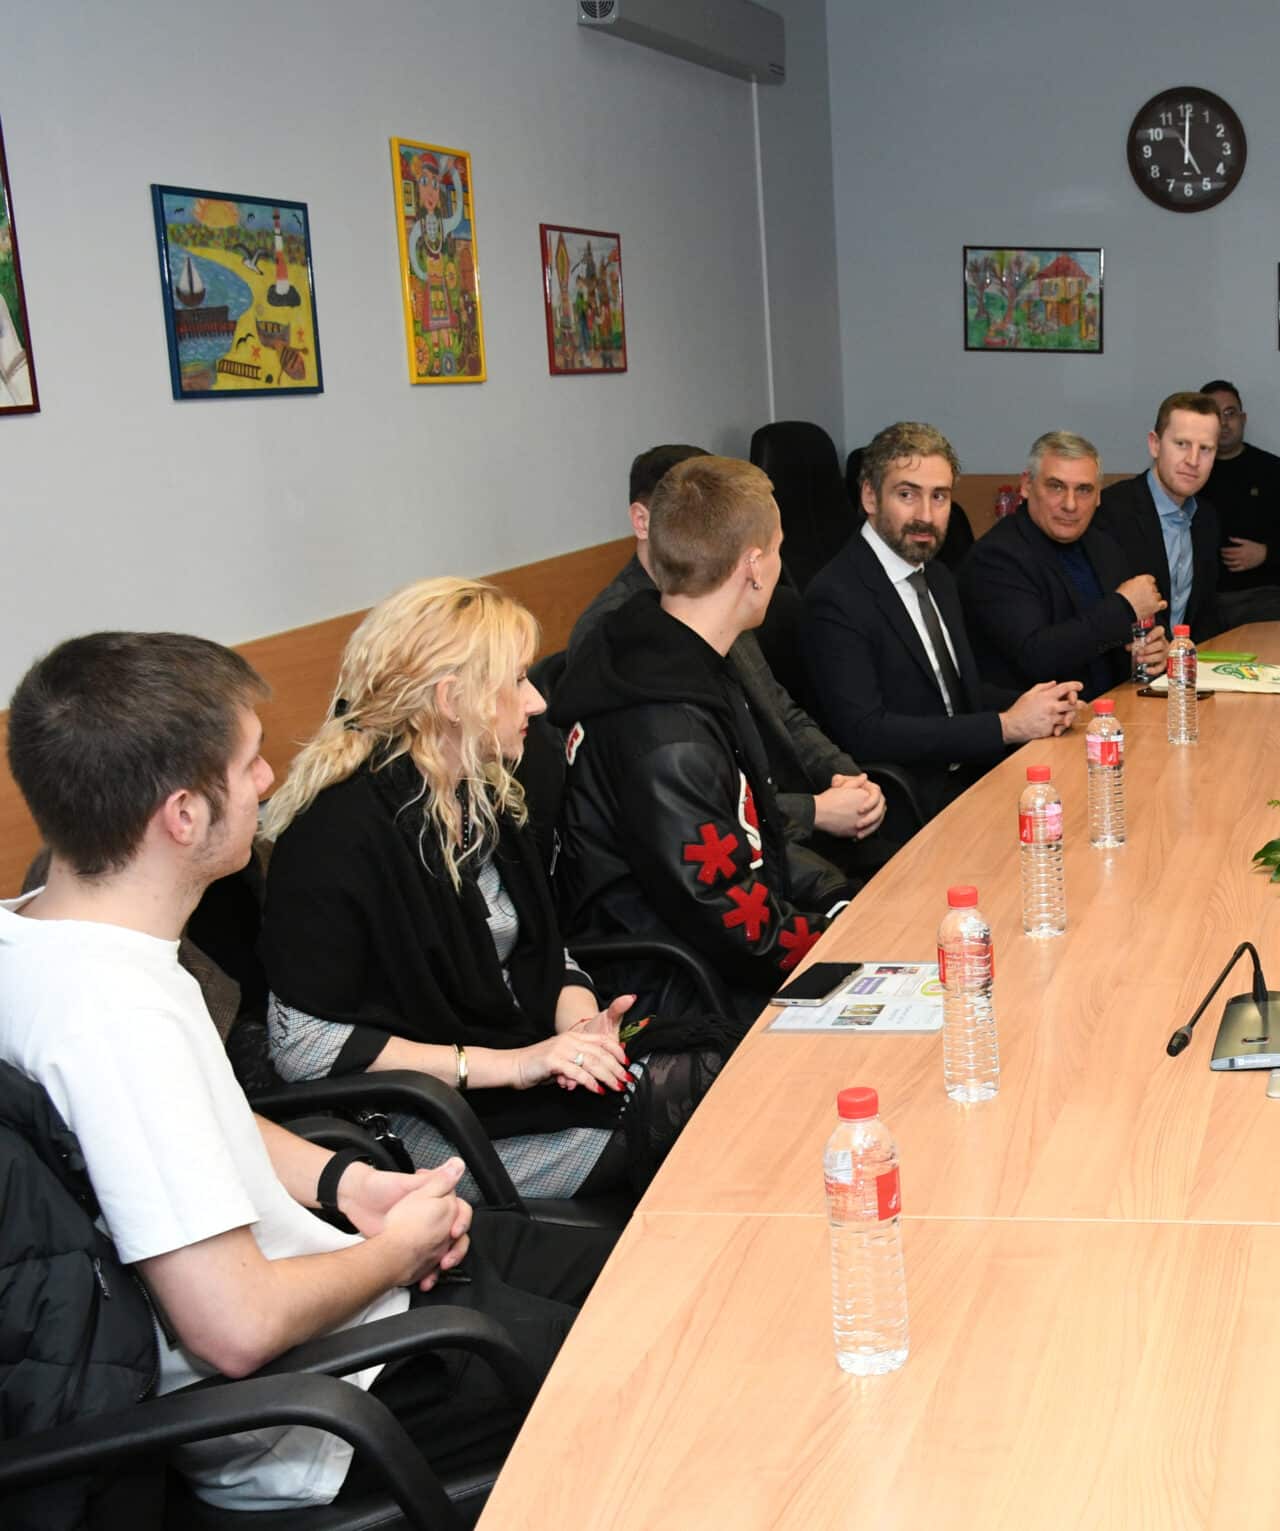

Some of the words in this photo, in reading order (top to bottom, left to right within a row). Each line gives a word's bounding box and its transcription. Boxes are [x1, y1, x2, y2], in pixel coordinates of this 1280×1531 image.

[1177, 104, 1193, 117] 12
[1202, 110, 1210, 123] 1
[1160, 112, 1173, 126] 11
[1148, 128, 1163, 141] 10
[1216, 124, 1225, 137] 2
[1143, 145, 1152, 158] 9
[1222, 142, 1231, 155] 3
[1151, 165, 1160, 178] 8
[1216, 162, 1225, 176] 4
[1166, 179, 1175, 192] 7
[1184, 183, 1193, 197] 6
[1202, 178, 1211, 191] 5
